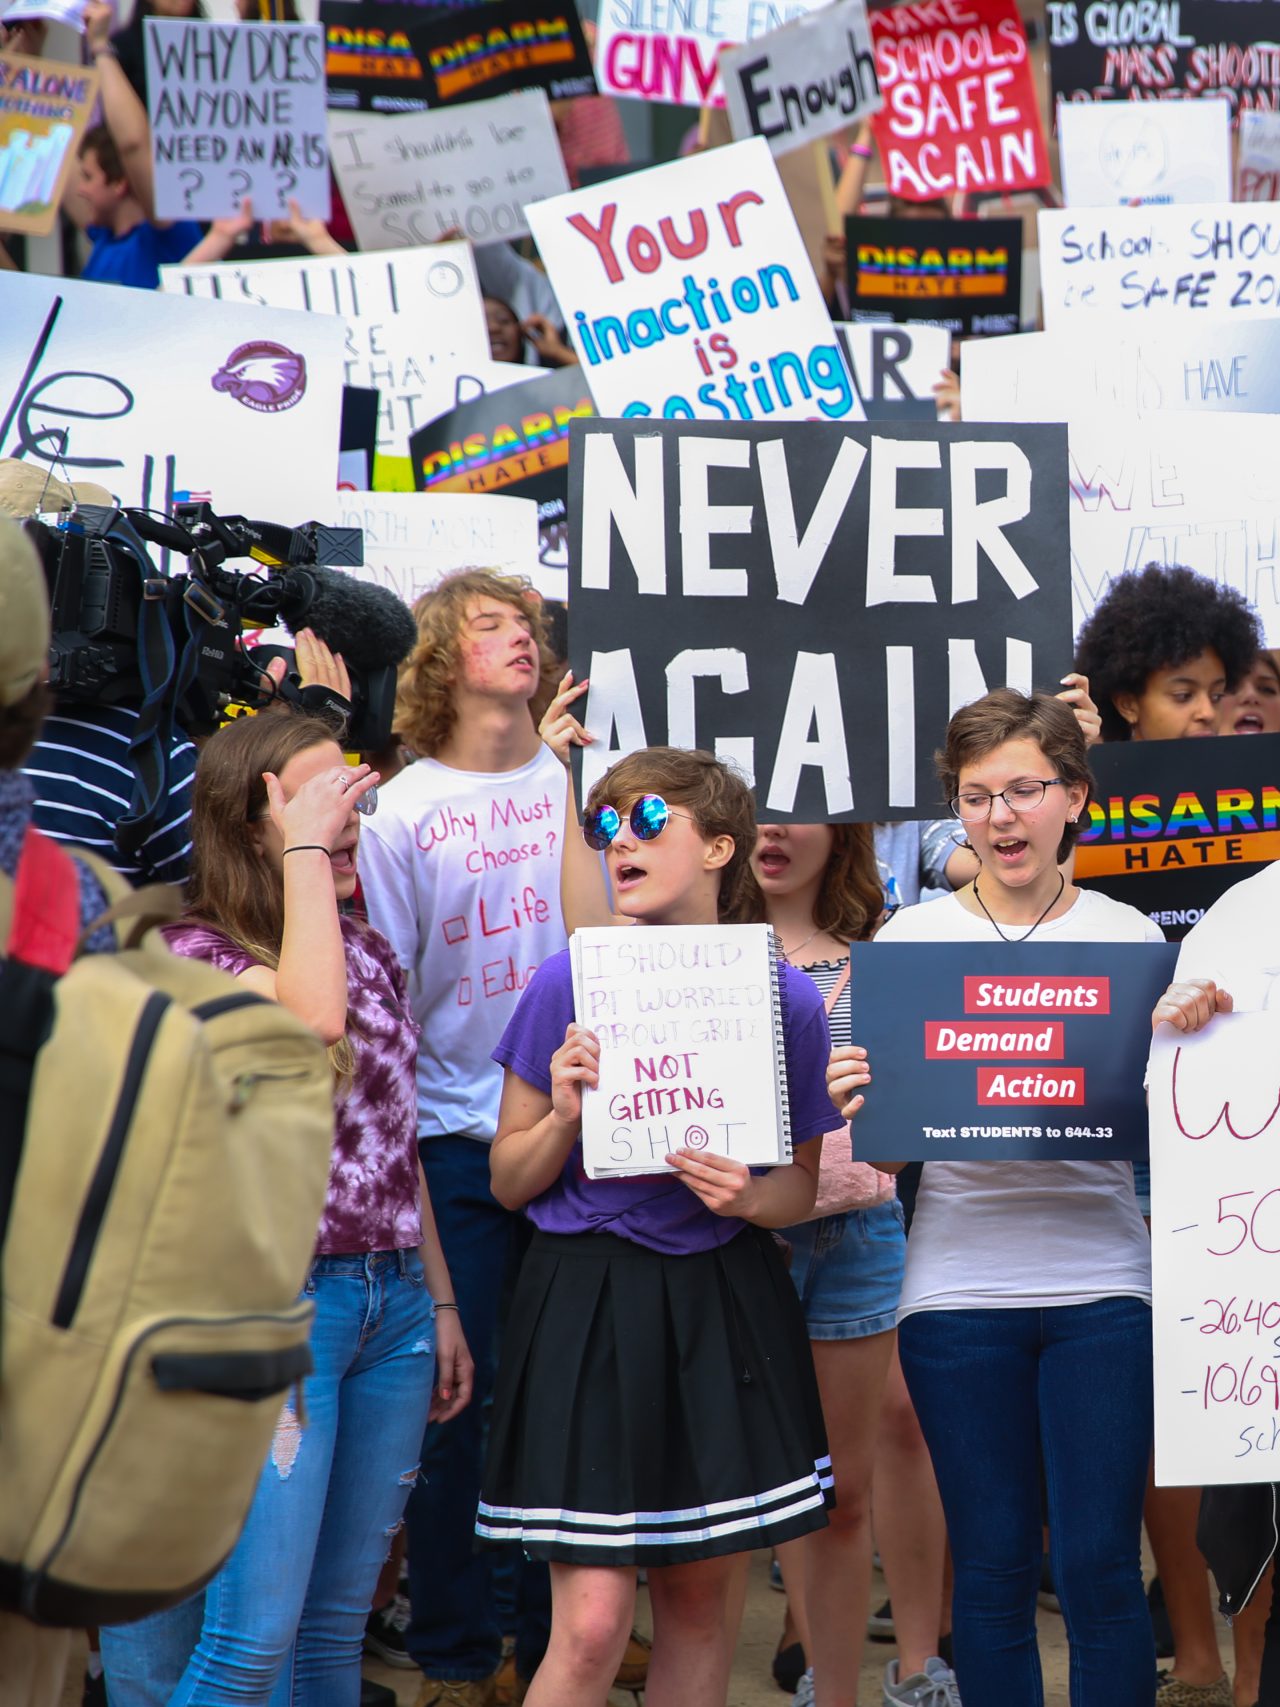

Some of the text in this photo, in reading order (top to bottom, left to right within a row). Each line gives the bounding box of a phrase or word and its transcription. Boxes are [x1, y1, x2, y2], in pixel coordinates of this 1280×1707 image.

[327, 24, 414, 57] DISA
[428, 16, 571, 76] DISARM
[1046, 1, 1196, 48] IS GLOBAL
[150, 23, 323, 84] WHY DOES
[606, 33, 684, 104] GUN
[875, 18, 1027, 88] SCHOOLS
[1102, 42, 1179, 89] MASS
[738, 30, 881, 139] Enough
[888, 68, 1021, 138] SAFE
[154, 86, 293, 129] ANYONE
[156, 134, 228, 164] NEED
[234, 134, 265, 165] AN
[334, 127, 375, 172] I
[566, 189, 764, 284] Your
[857, 245, 1008, 276] DISARM
[1119, 269, 1218, 311] SAFE
[574, 263, 800, 366] inaction
[693, 333, 739, 377] is
[1183, 353, 1249, 402] HAVE
[422, 396, 594, 486] DISARM
[468, 449, 550, 491] HATE
[580, 431, 1040, 608] NEVER
[413, 792, 554, 852] Why Must
[1124, 839, 1243, 870] HATE
[479, 886, 550, 937] Life
[583, 942, 743, 980] I SHOULD
[635, 984, 766, 1014] WORRIED
[976, 982, 1100, 1008] Students
[593, 1019, 681, 1049] ABOUT
[936, 1026, 1054, 1052] Demand
[633, 1053, 700, 1084] NOT
[986, 1073, 1077, 1098] Action
[608, 1086, 725, 1123] GETTING
[608, 1122, 748, 1163] SHOT
[922, 1126, 957, 1138] Text
[960, 1126, 1042, 1139] STUDENTS
[1046, 1126, 1061, 1138] to
